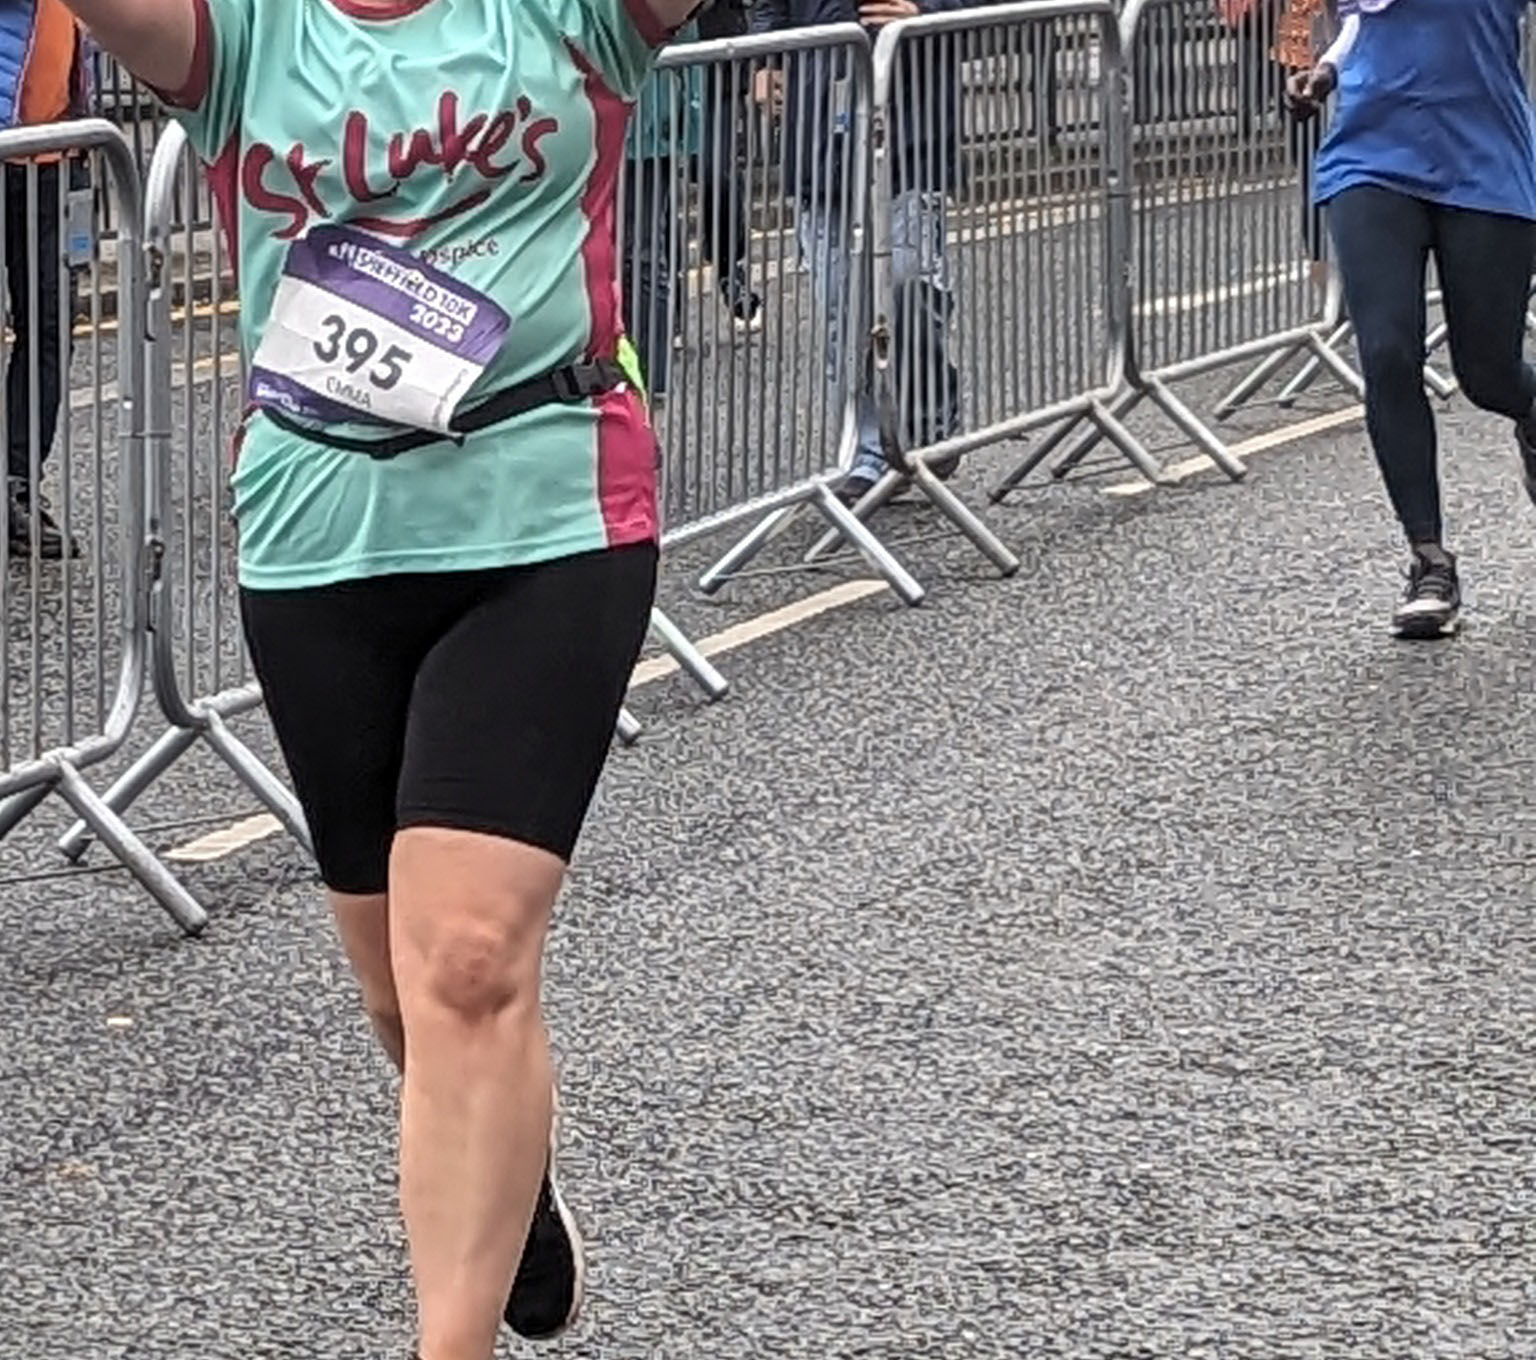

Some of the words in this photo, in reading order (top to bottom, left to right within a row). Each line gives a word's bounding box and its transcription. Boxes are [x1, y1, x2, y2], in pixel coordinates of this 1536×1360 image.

[242, 142, 332, 239] St
[344, 90, 558, 202] Luke's
[409, 303, 466, 343] 2023
[439, 293, 473, 320] 10K
[313, 314, 413, 391] 395
